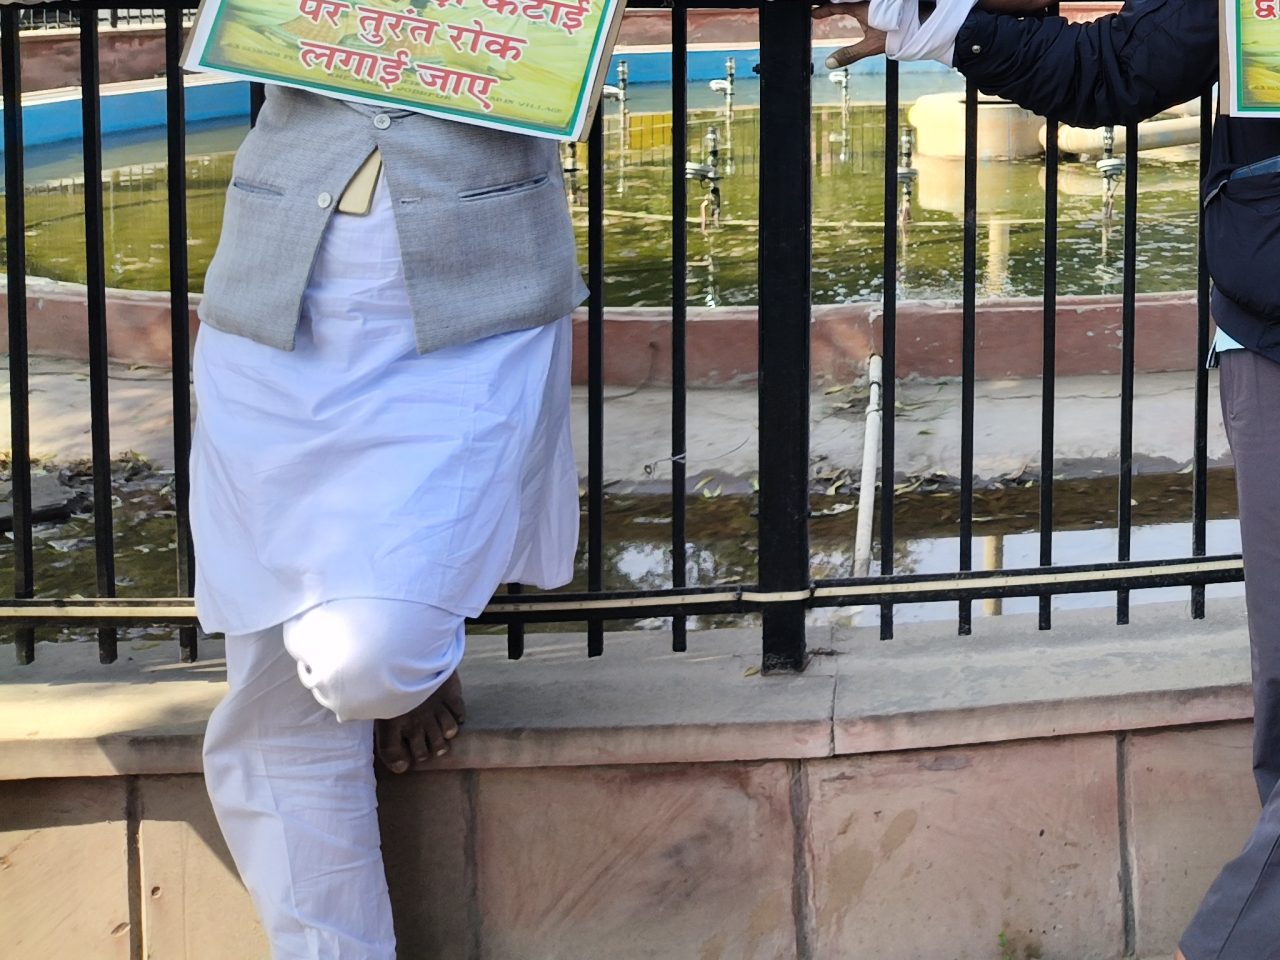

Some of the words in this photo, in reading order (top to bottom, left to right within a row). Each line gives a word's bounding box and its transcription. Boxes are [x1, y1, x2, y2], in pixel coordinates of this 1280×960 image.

[357, 6, 438, 44] तुरंत
[449, 20, 526, 62] रोक
[301, 42, 409, 89] लगाई
[417, 62, 498, 109] जाए
